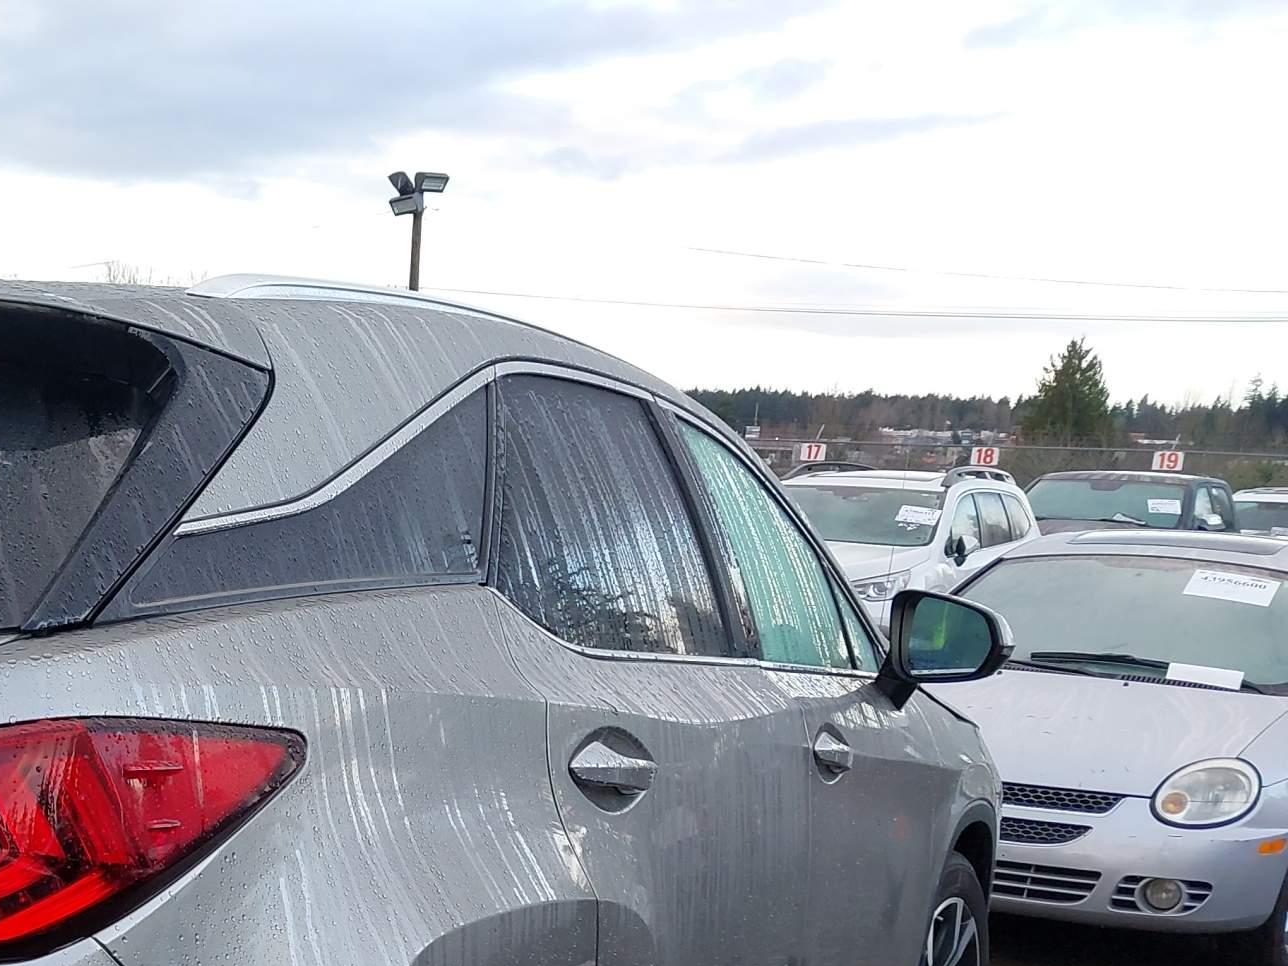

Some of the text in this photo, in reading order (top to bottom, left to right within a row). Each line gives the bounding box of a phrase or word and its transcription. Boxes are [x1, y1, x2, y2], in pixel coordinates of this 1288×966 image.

[806, 444, 822, 460] 17
[976, 447, 995, 465] 18
[1159, 452, 1179, 470] 19
